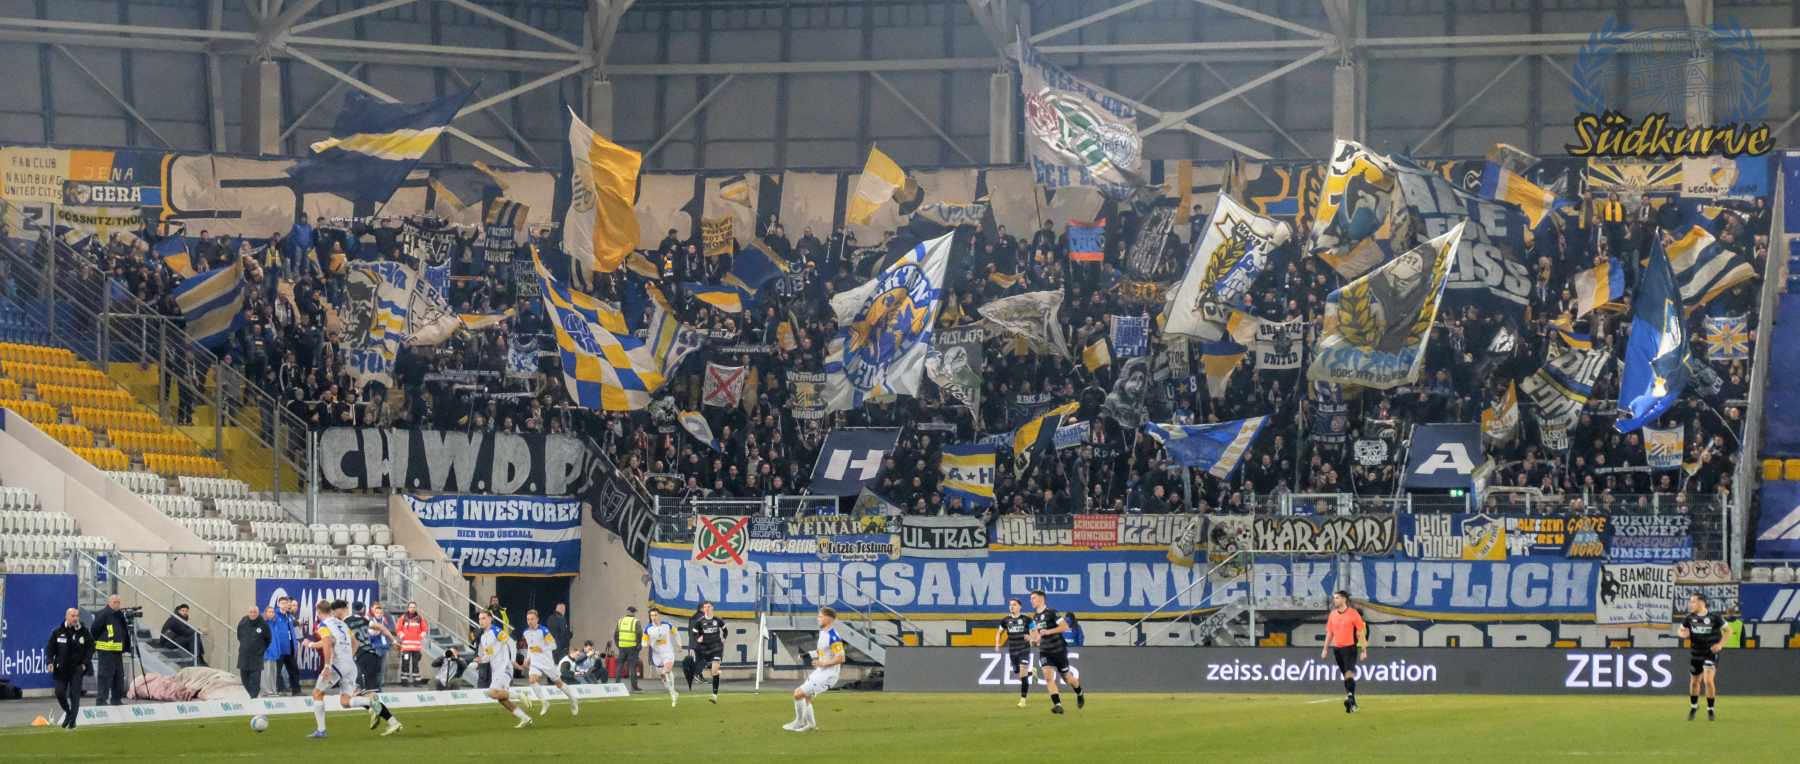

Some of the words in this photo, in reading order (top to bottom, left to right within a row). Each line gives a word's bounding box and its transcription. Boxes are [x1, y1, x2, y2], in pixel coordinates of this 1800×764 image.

[91, 185, 142, 202] GERA
[1263, 352, 1299, 366] UNITED
[824, 449, 884, 480] H
[462, 499, 580, 523] INVESTOREN
[787, 521, 863, 536] WEIMAR
[1610, 515, 1692, 526] ZUKUNFTS
[903, 527, 988, 548] ULTRAS
[1254, 515, 1395, 552] HARAKIRI
[1615, 526, 1689, 536] KONZEPT
[1612, 536, 1693, 547] KONSEQUENT
[460, 547, 557, 568] FUSSBALL
[1610, 547, 1692, 558] UMSETZEN
[650, 556, 1006, 607] UNBEUGSAM
[1023, 576, 1070, 593] UND
[1619, 567, 1674, 583] BAMBULE
[1620, 583, 1674, 599] RANDALE
[1206, 658, 1438, 683] zeiss.de/innovation
[1565, 653, 1673, 688] ZEISS
